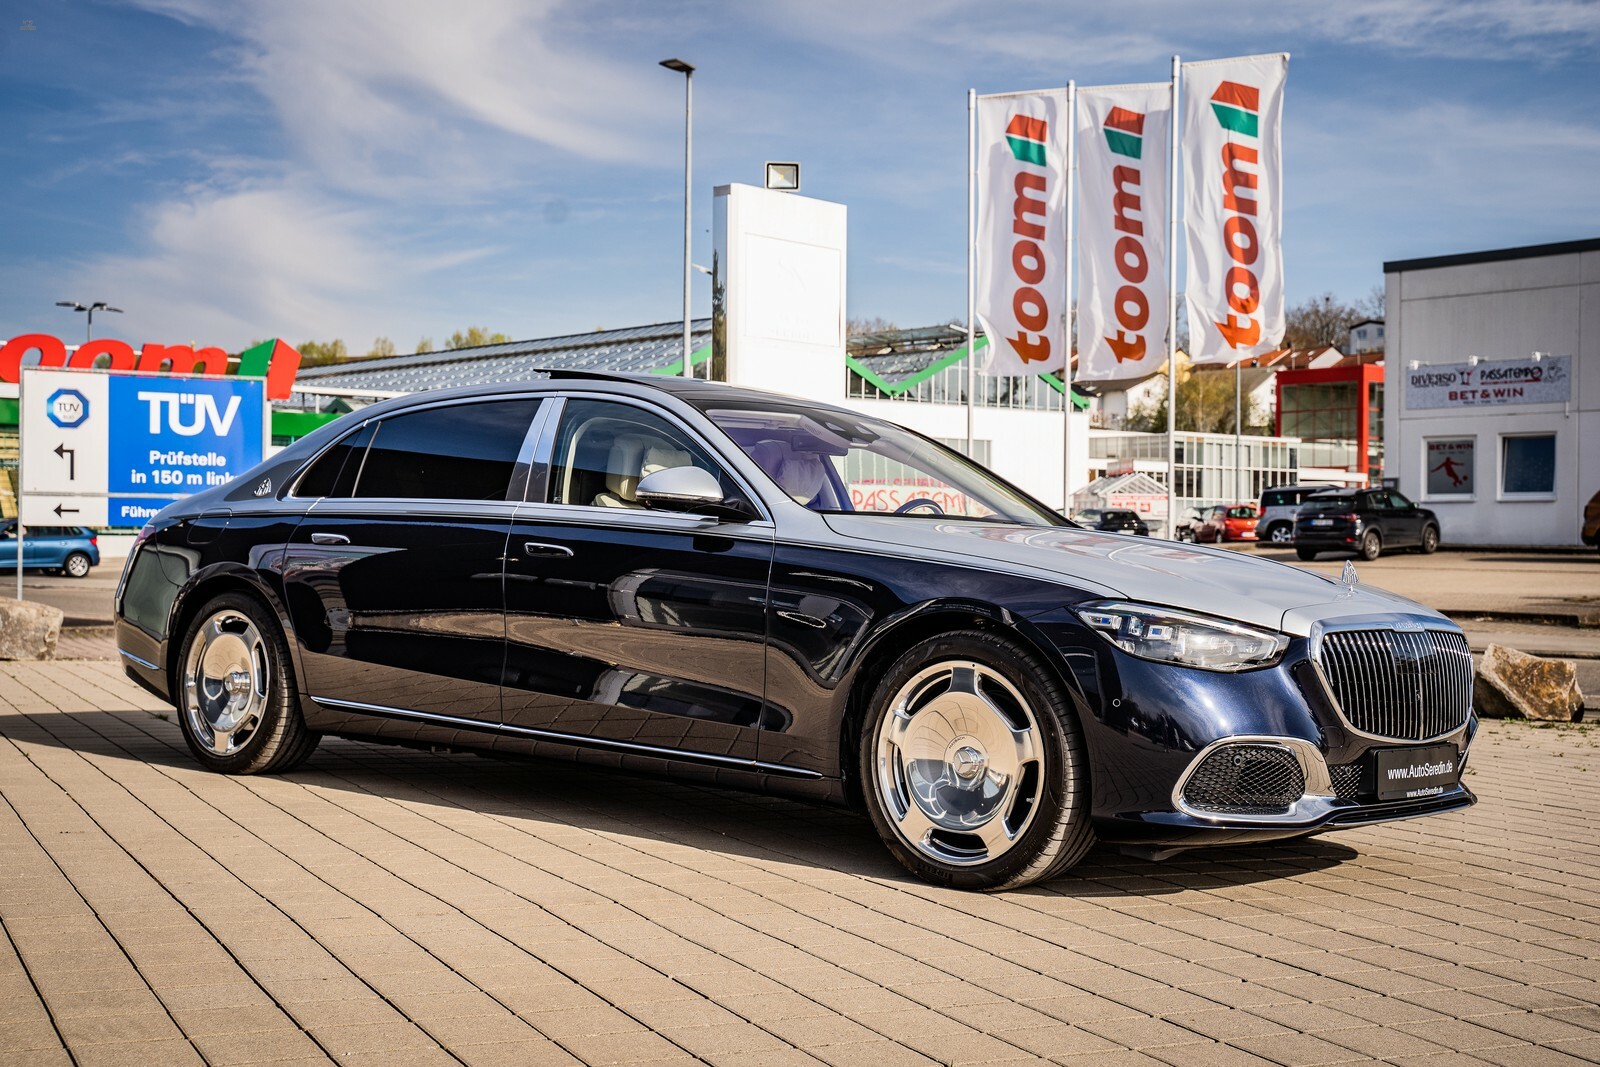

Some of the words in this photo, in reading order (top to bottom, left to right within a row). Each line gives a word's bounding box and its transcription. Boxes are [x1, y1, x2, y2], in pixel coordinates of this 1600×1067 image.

[1006, 171, 1051, 365] toom
[1104, 164, 1150, 364] toom
[1214, 142, 1261, 350] toom
[137, 390, 242, 437] TÜV
[131, 469, 147, 484] in
[151, 470, 184, 485] 150
[186, 472, 203, 485] m
[206, 471, 239, 486] link
[149, 450, 227, 467] Prüfstelle
[1388, 760, 1453, 780] www.AutoSeredin.de
